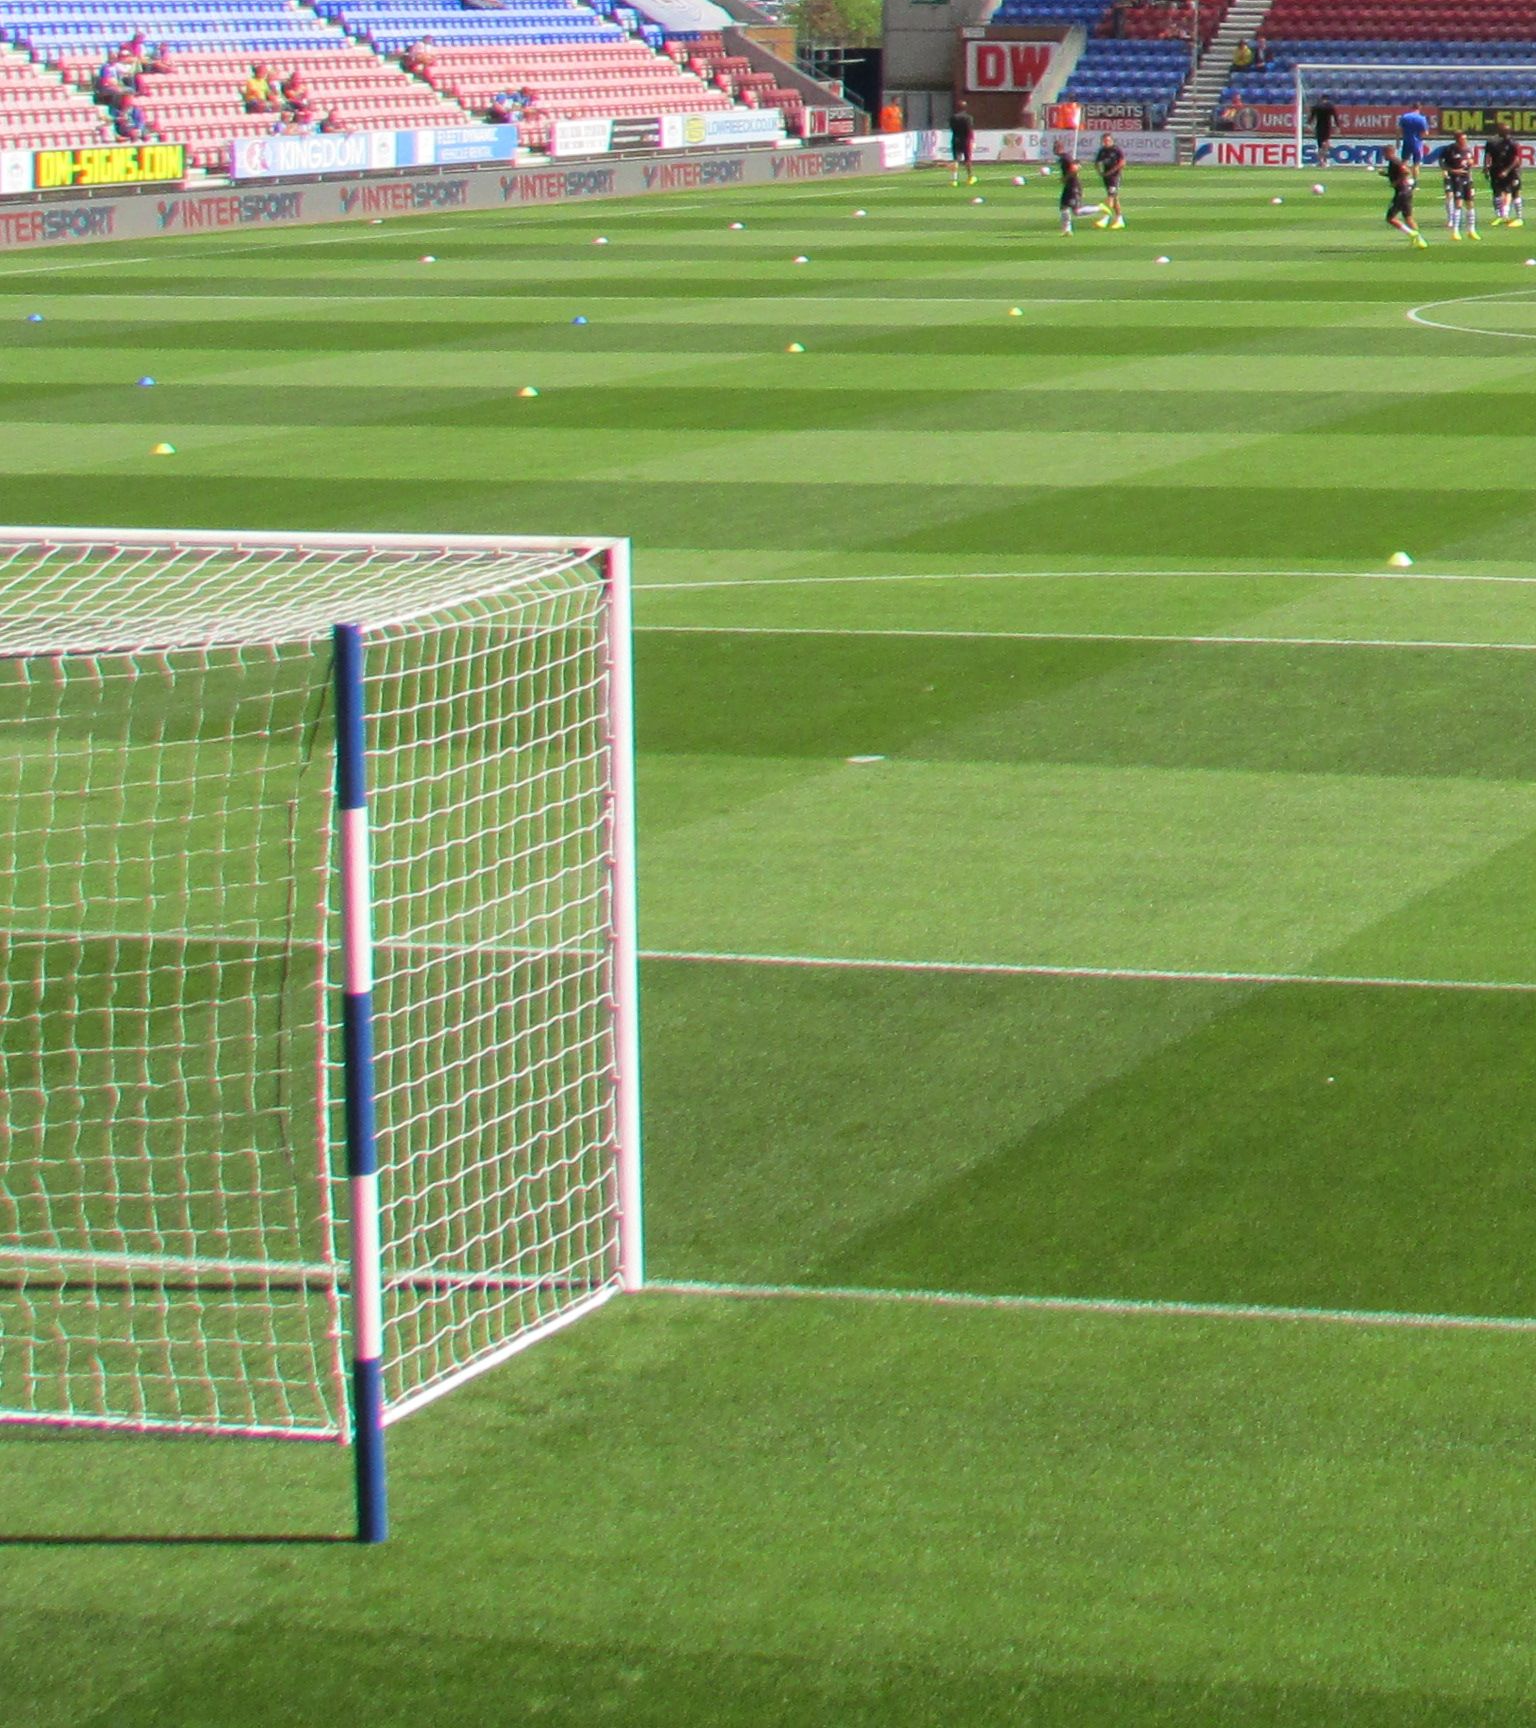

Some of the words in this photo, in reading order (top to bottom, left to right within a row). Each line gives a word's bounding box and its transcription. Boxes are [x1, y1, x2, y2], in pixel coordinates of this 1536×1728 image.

[976, 45, 1052, 87] DW
[1087, 105, 1143, 117] SPORTS
[1087, 119, 1143, 131] FITNESS
[1354, 114, 1392, 128] MINT
[280, 136, 367, 173] KINGDOM
[1029, 134, 1048, 149] Be
[38, 144, 185, 188] DM-SIGNS.COM
[660, 159, 745, 189] INTERSPORT
[787, 150, 864, 178] INTERSPORT
[361, 179, 469, 213] INTERSPORT
[519, 169, 616, 201] INTERSPORT
[182, 191, 305, 229] INTERSPORT
